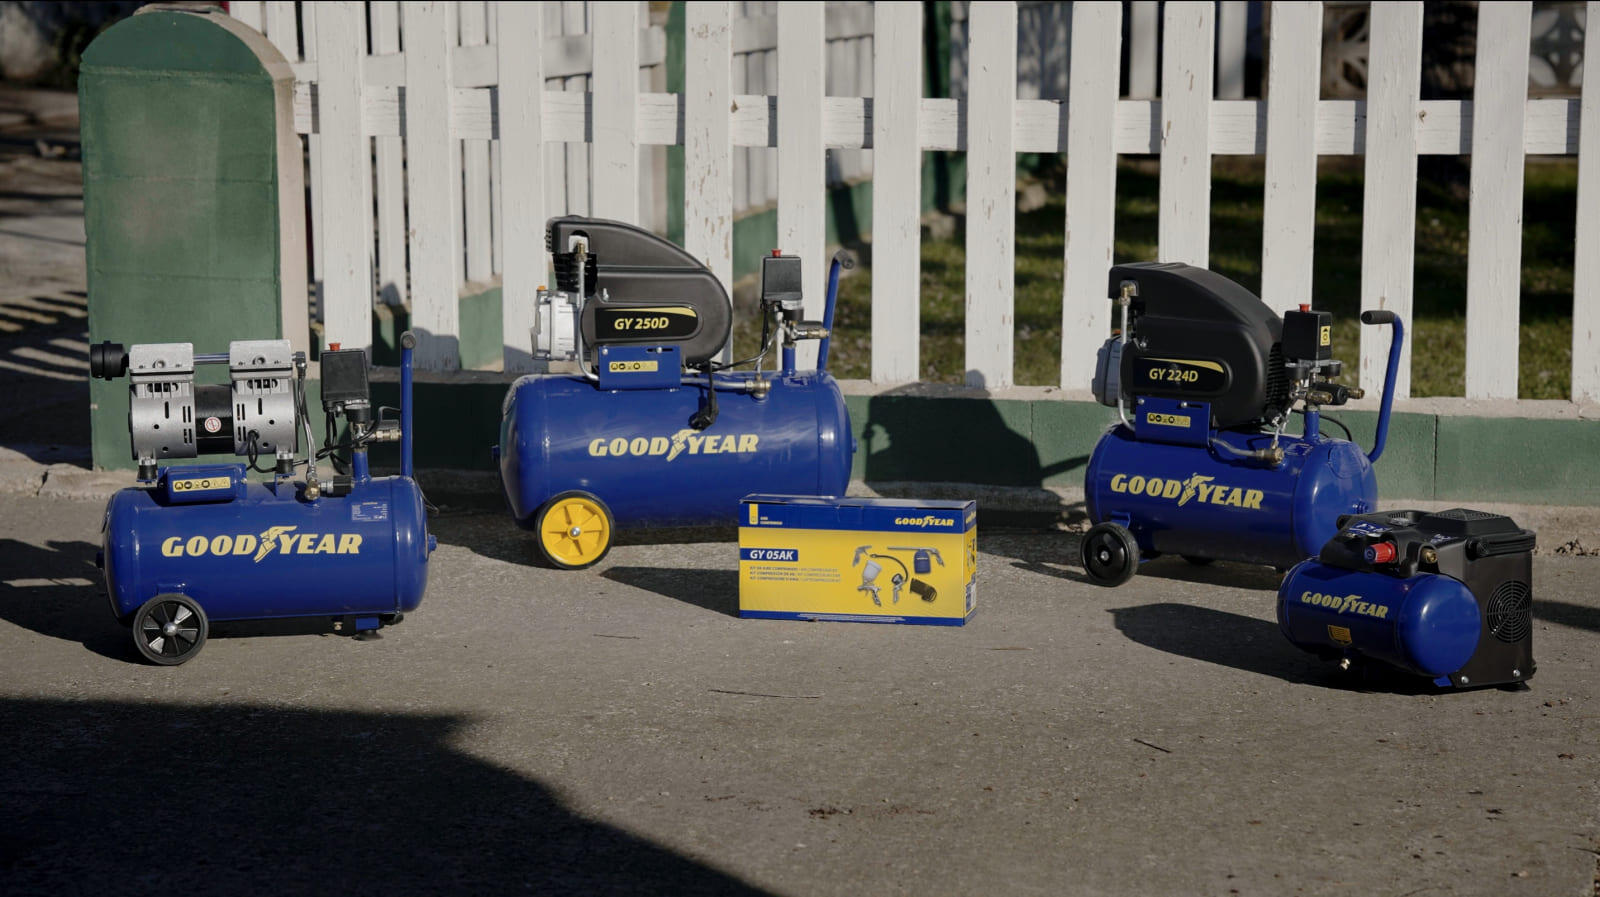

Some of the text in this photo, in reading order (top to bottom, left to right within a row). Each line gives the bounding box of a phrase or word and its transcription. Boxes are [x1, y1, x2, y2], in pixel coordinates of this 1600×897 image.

[614, 317, 669, 331] GY 250D
[1149, 368, 1199, 383] GY 224D
[588, 433, 759, 458] GOODYEAR
[1110, 474, 1264, 510] GOODYEAR
[895, 517, 955, 527] GOODYEAR
[161, 532, 363, 558] GOODYEAR
[750, 549, 794, 561] GY 05AK
[1301, 591, 1389, 619] GOODYEAR
